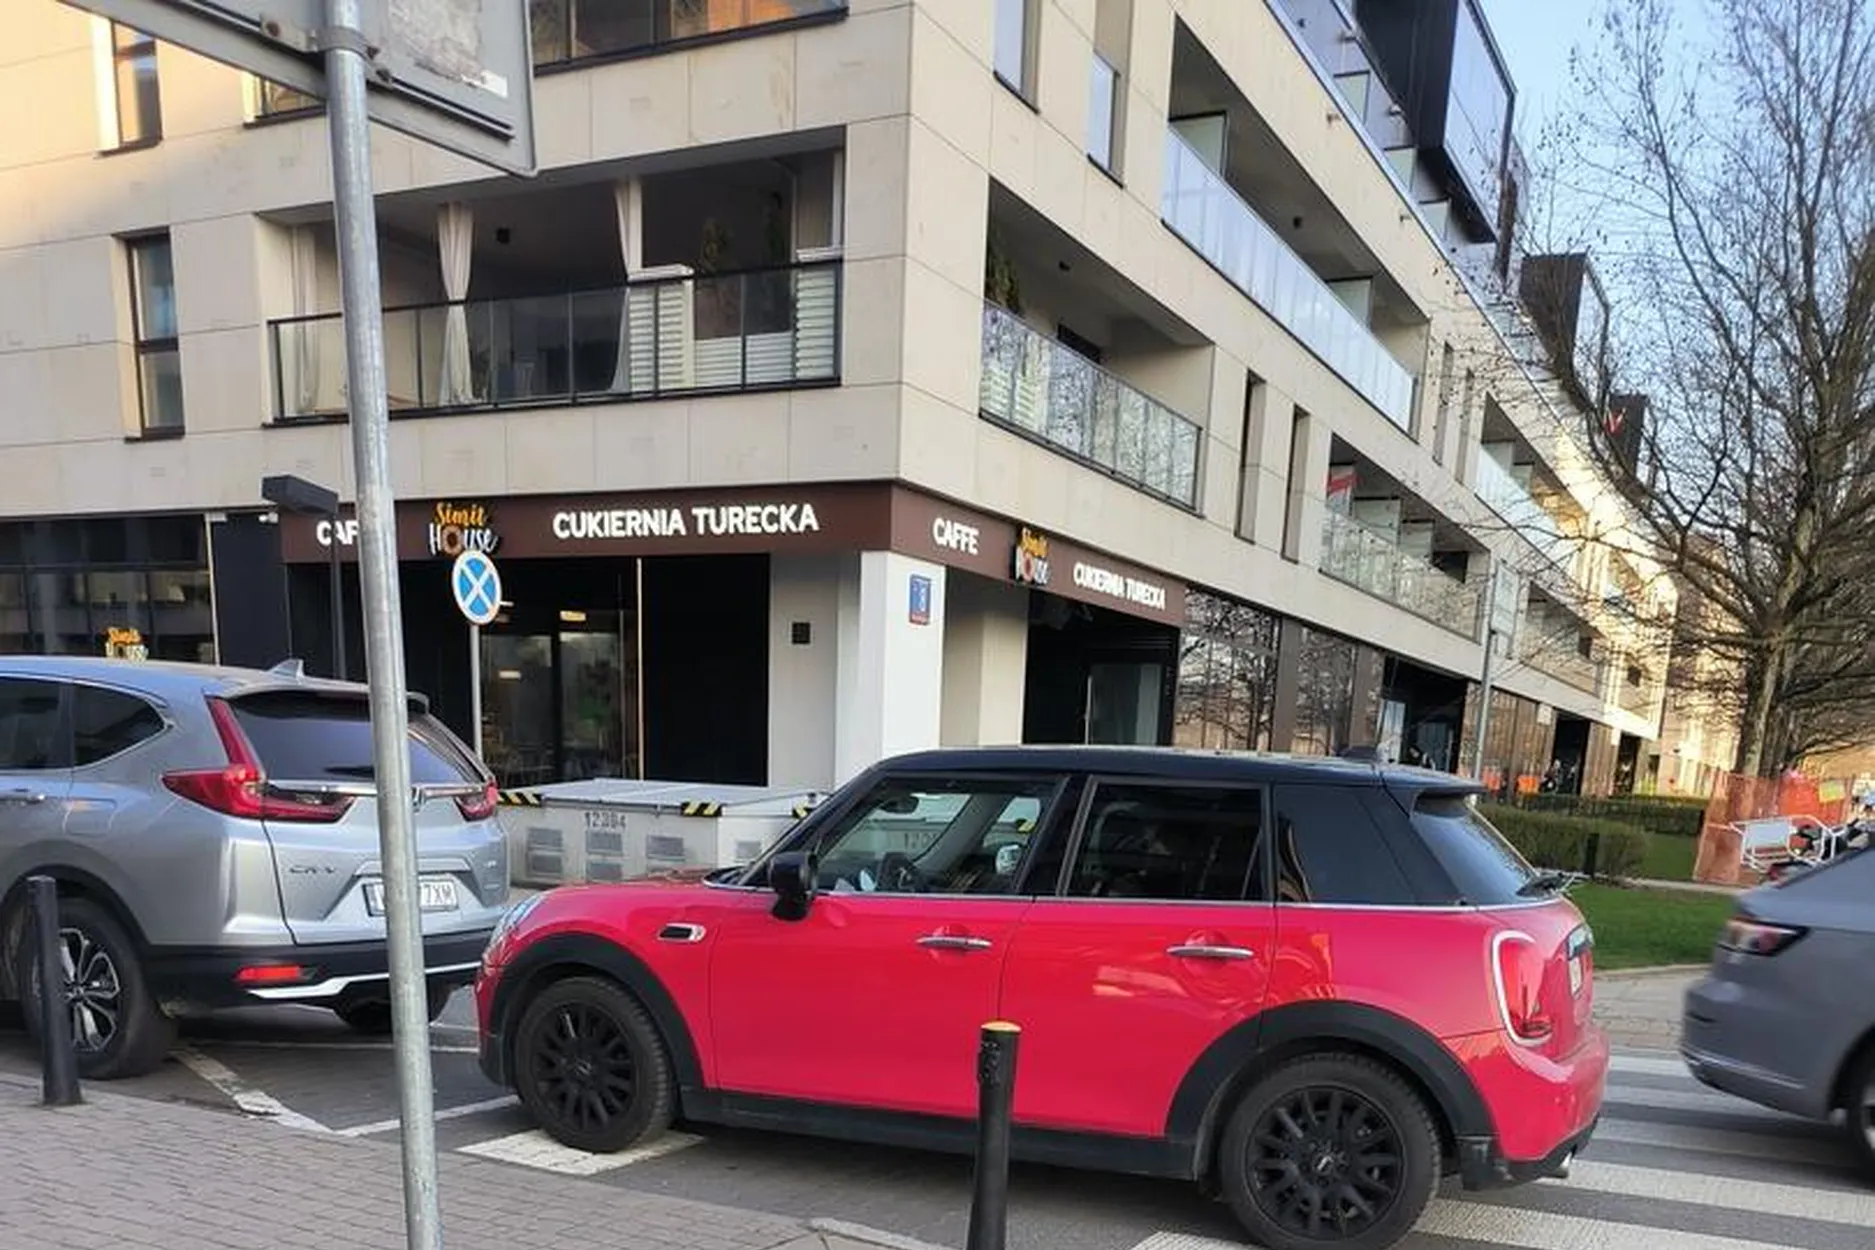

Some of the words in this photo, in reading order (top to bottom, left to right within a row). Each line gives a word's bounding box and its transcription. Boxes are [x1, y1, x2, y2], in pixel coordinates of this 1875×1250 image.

[435, 502, 485, 527] Simit
[552, 508, 687, 538] CUKIERNIA
[692, 503, 820, 535] TURECKA
[316, 520, 359, 546] CAF
[932, 517, 980, 556] CAFFE
[1073, 561, 1125, 598] CUKIERNIA
[1125, 577, 1166, 611] TURECKA
